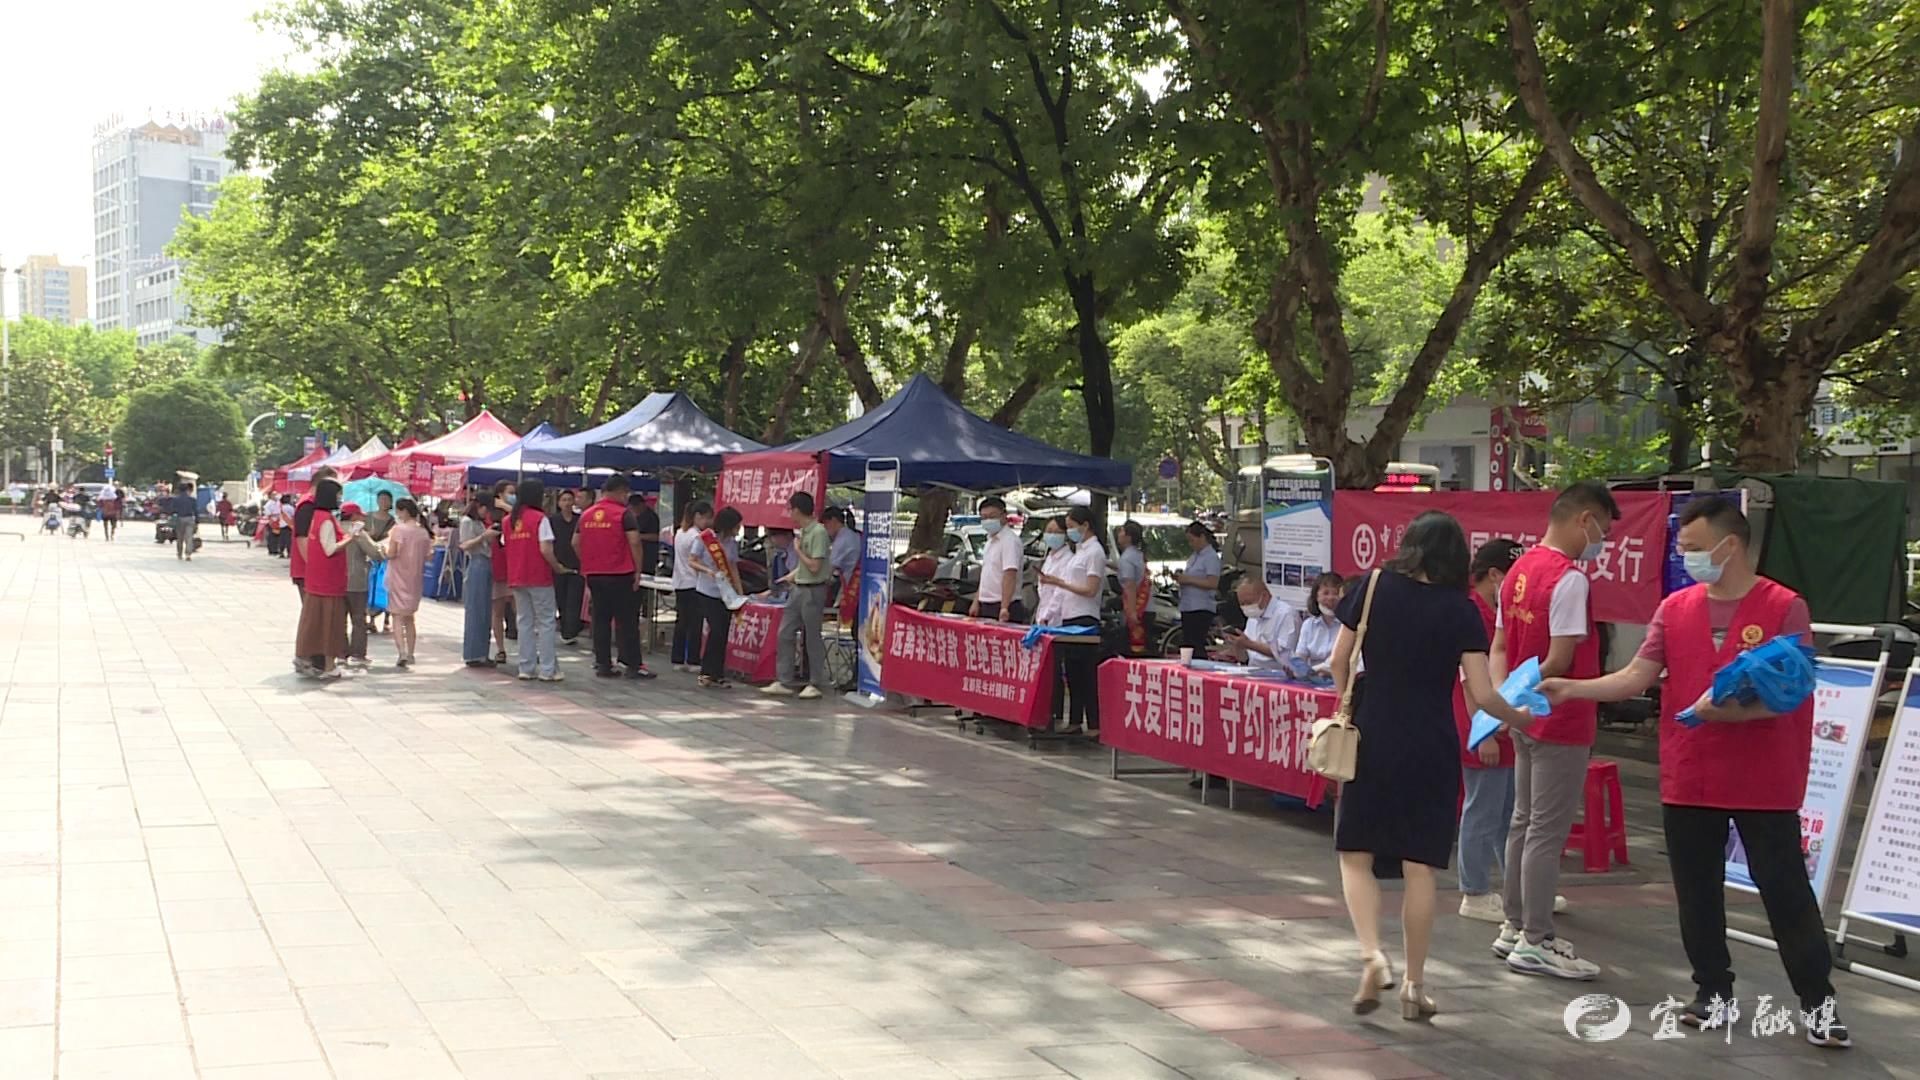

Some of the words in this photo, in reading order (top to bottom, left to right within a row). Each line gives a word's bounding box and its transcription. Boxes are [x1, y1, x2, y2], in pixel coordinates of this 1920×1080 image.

[722, 468, 764, 505] 购买国债
[890, 621, 960, 669] 远离非法贷款
[1124, 661, 1204, 746] 关爱信用
